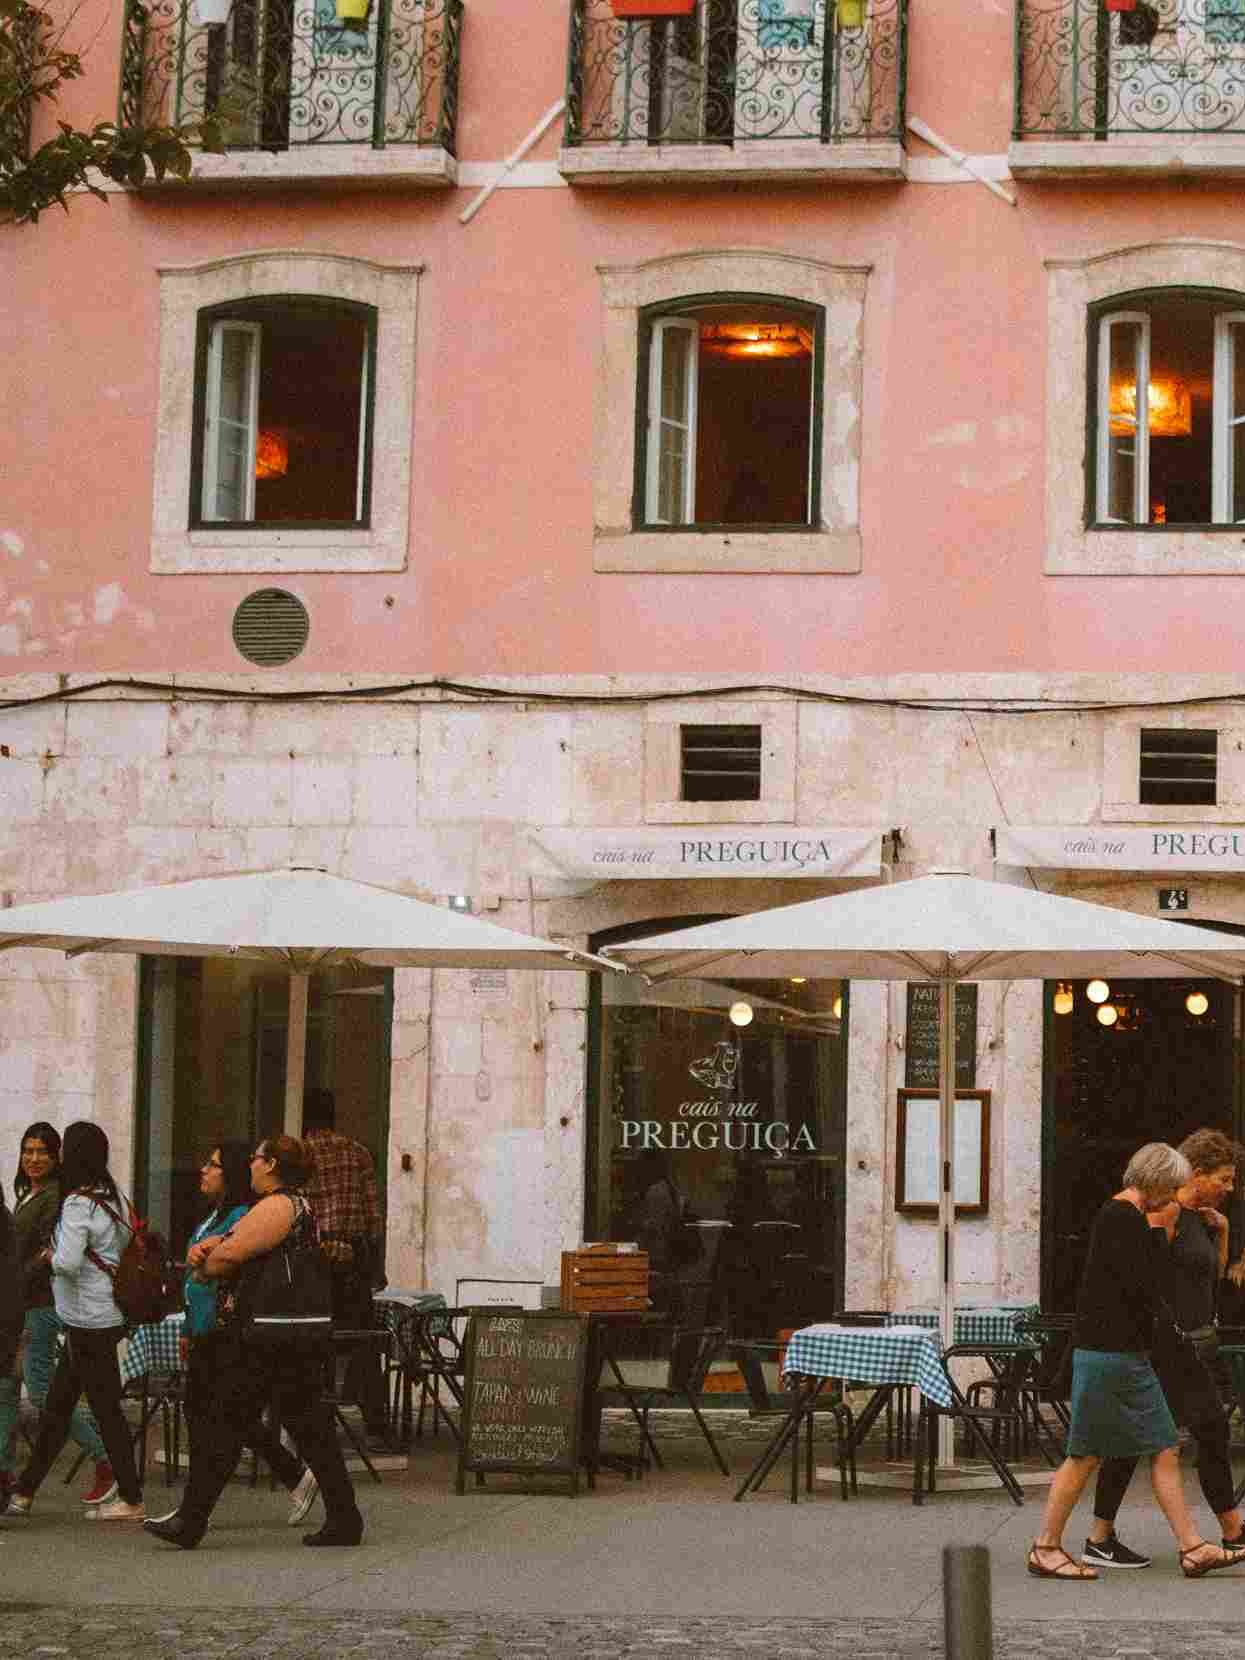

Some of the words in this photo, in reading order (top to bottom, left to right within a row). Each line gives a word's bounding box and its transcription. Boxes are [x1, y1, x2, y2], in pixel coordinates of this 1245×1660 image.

[680, 840, 831, 868] PREGUIÇA
[679, 1096, 721, 1117] cais
[727, 1101, 758, 1117] na
[620, 1120, 817, 1159] PREGUIÇA
[499, 1337, 522, 1358] DAY
